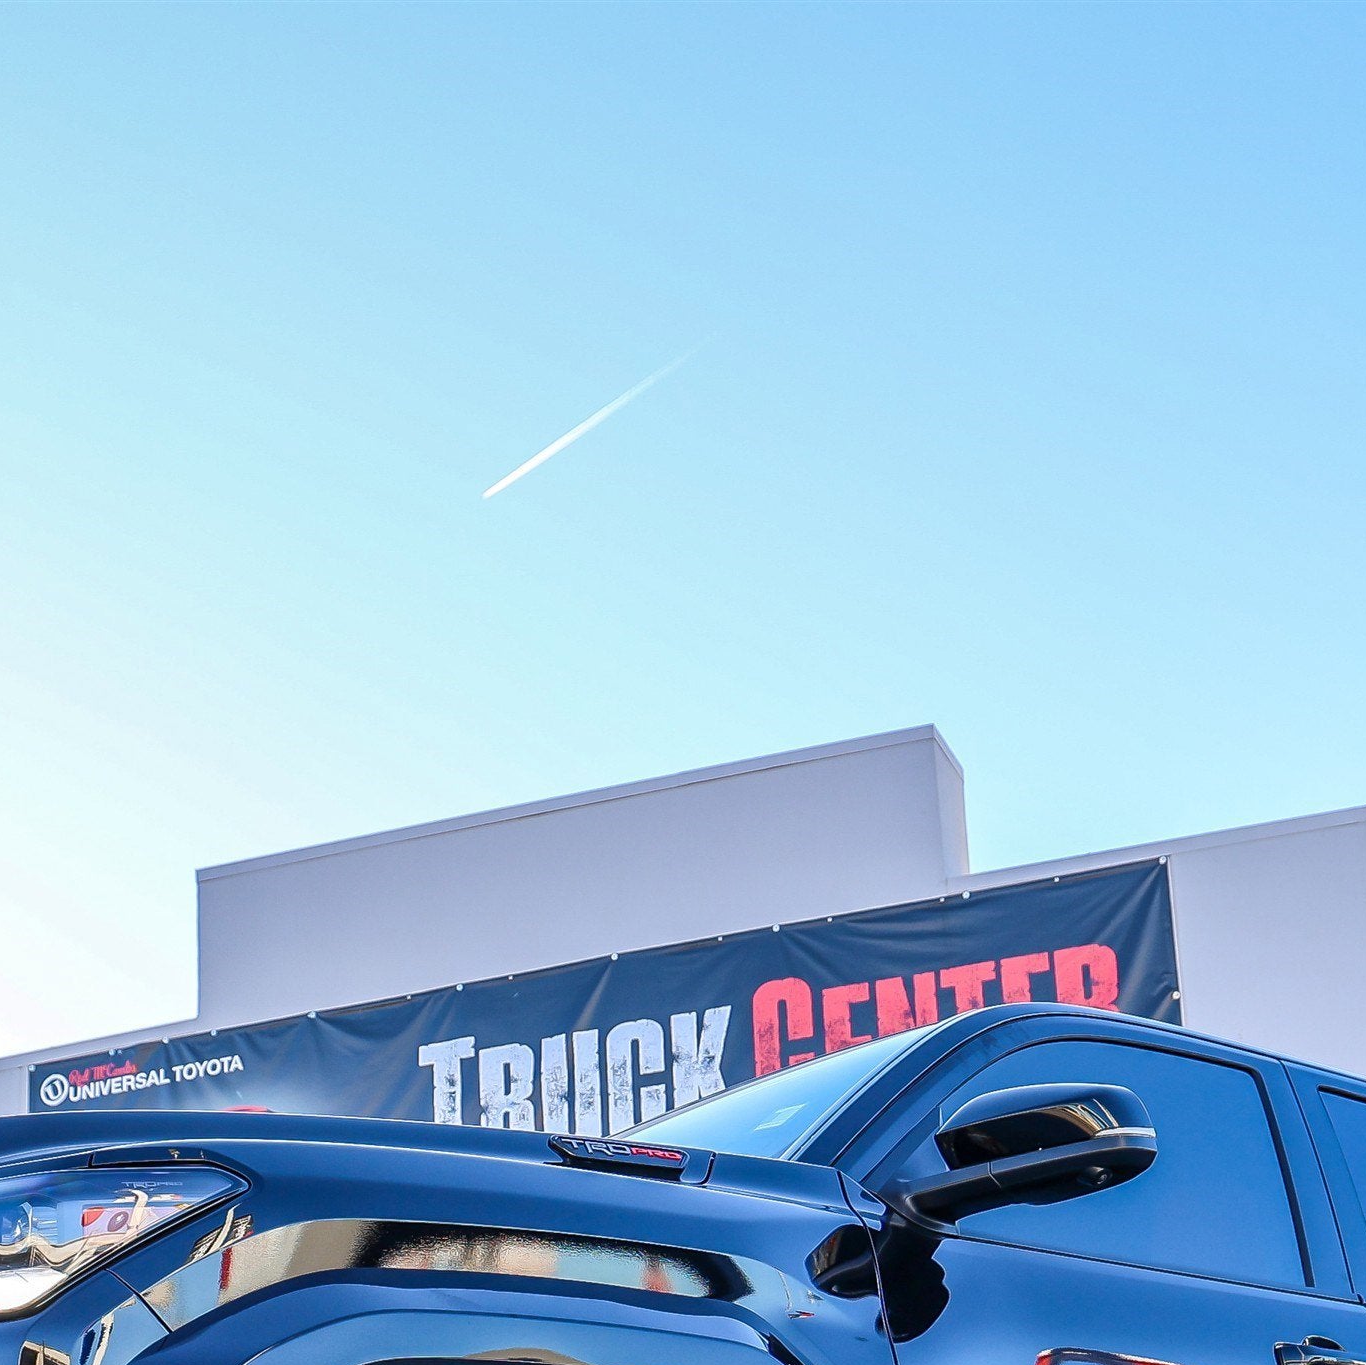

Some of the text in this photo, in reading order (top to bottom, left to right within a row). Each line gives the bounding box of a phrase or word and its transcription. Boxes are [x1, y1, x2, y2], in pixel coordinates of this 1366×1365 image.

[68, 1068, 170, 1102] UNIVERSAL
[172, 1054, 244, 1082] TOYOTA
[419, 1004, 732, 1137] TRUCK
